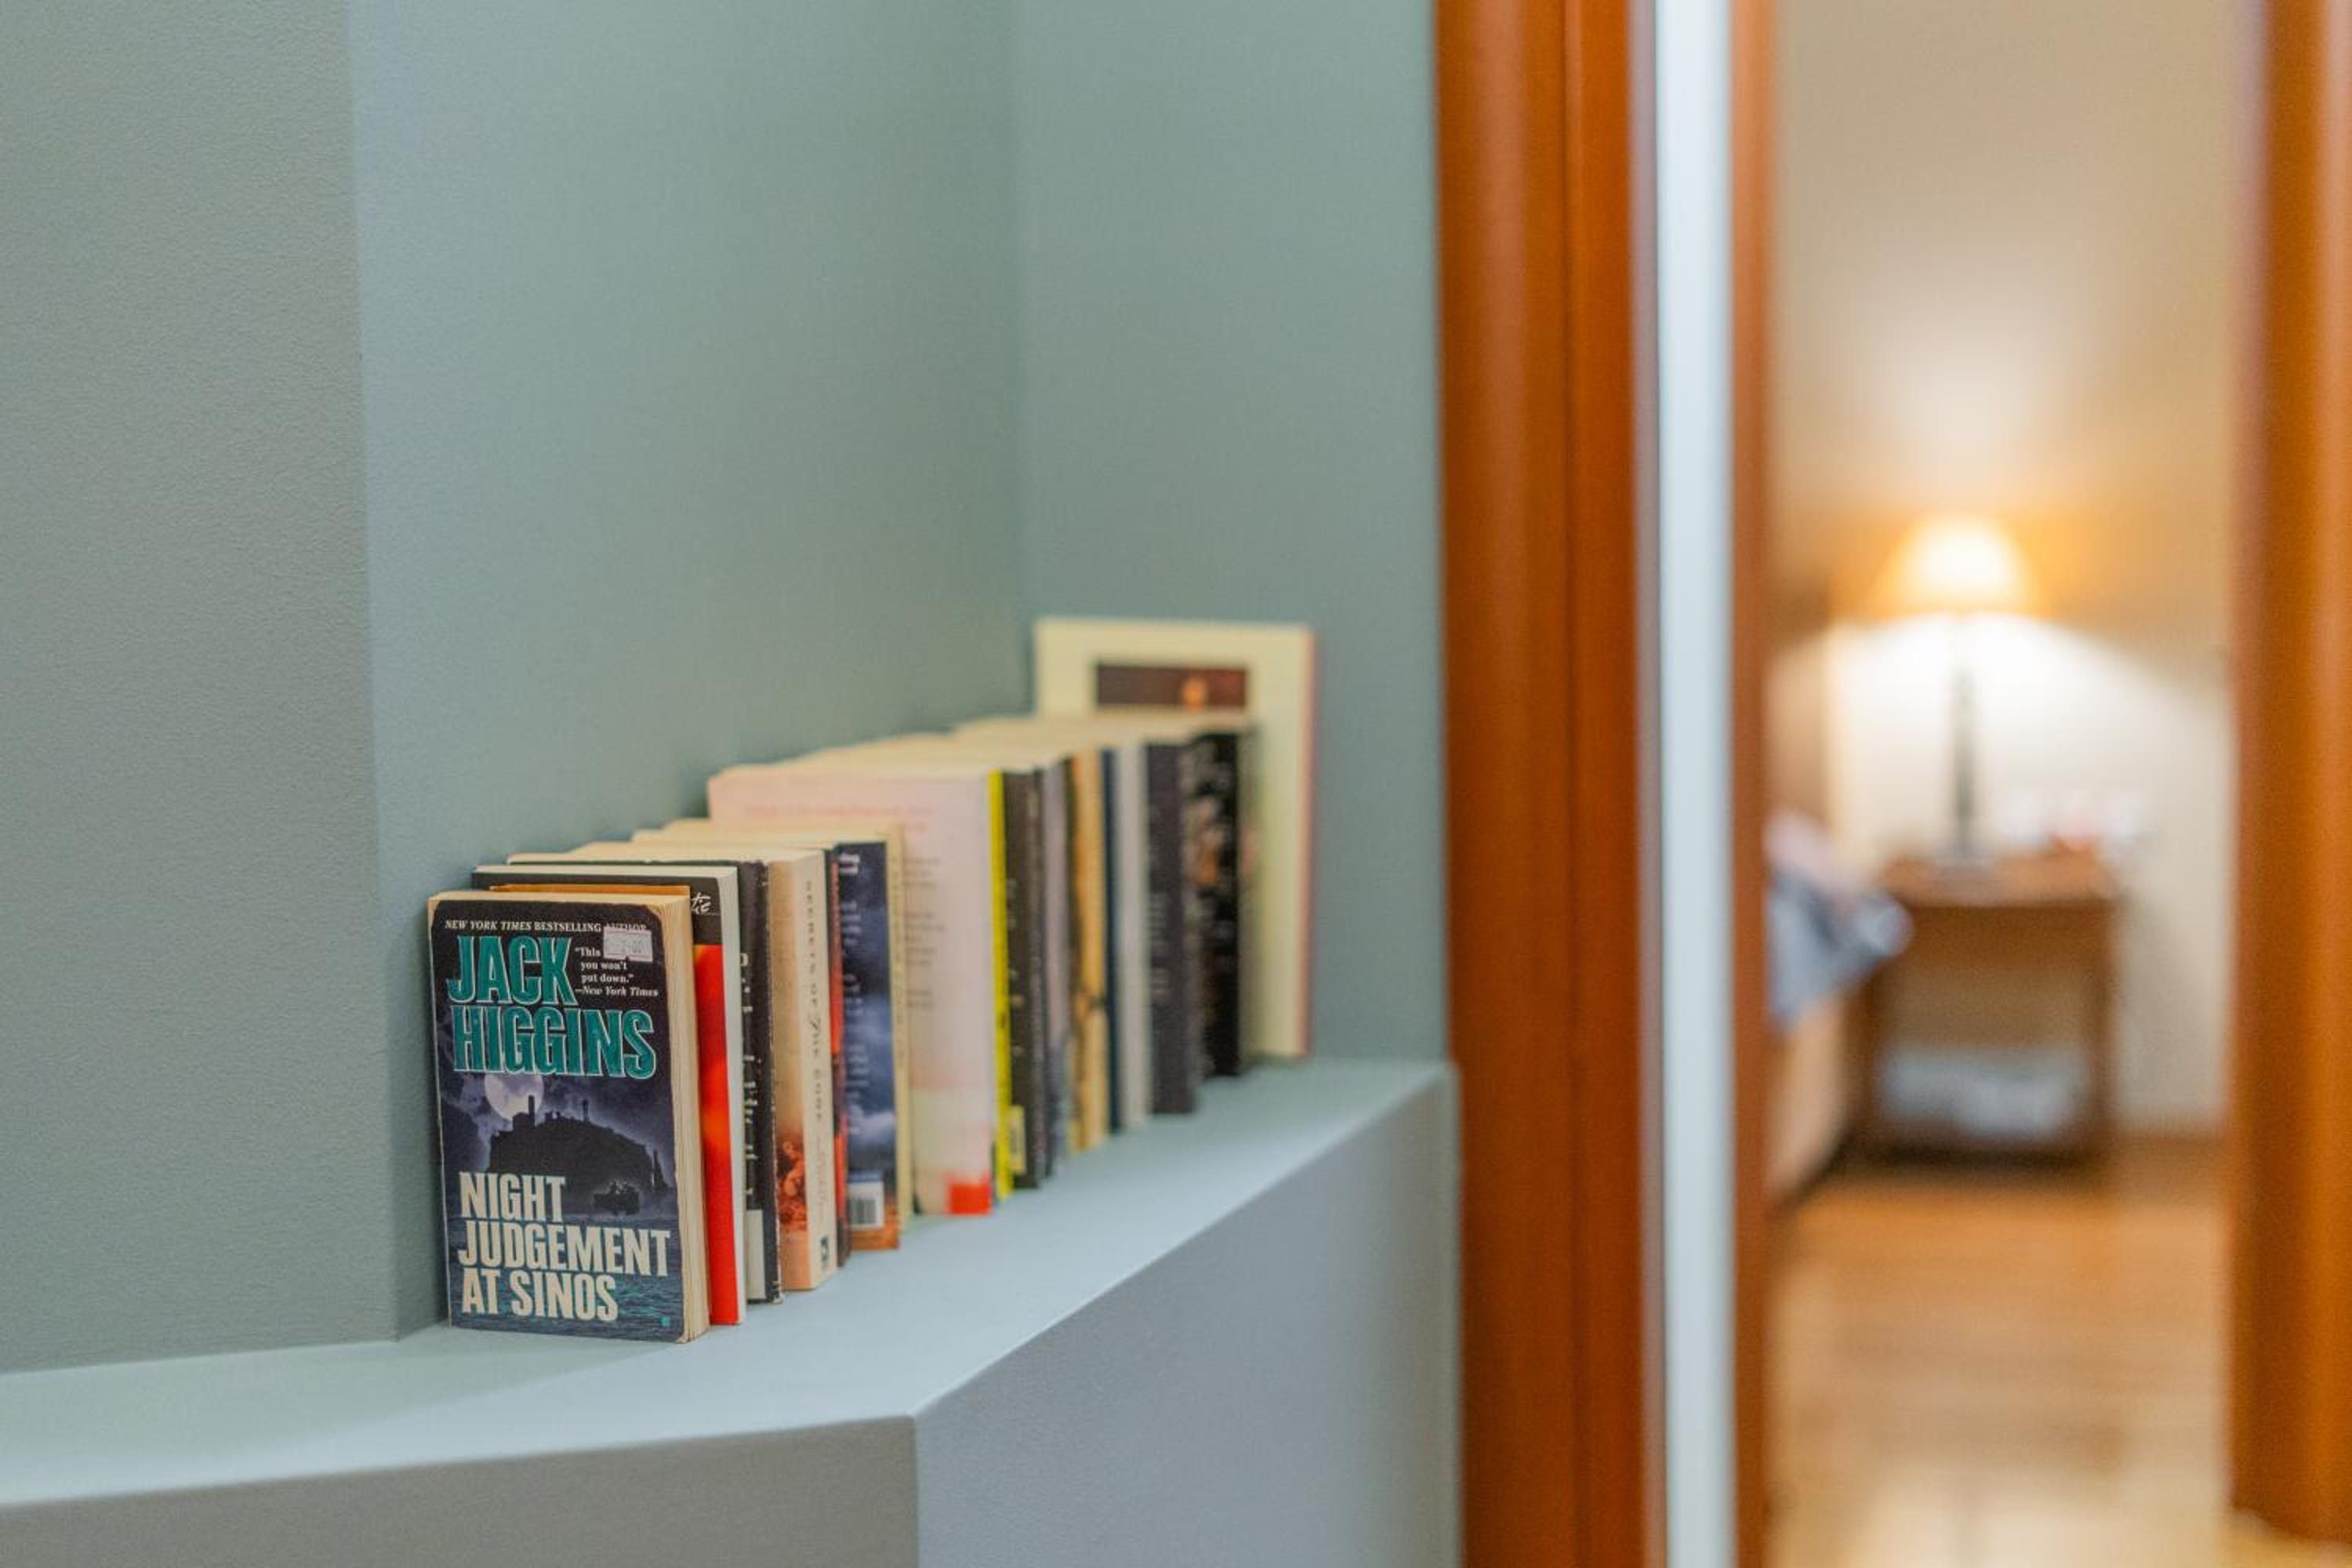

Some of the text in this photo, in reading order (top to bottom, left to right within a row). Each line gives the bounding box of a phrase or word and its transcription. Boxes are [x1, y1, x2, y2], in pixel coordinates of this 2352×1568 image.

[445, 920, 468, 929] NEW
[470, 920, 498, 930] YORK
[500, 921, 532, 931] TIMES
[534, 921, 602, 932] BESTSELLING
[446, 935, 578, 1005] JACK
[580, 960, 628, 971] you won't
[581, 974, 597, 984] put
[605, 986, 626, 996] York
[630, 987, 659, 996] Times
[452, 1005, 656, 1080] HIGGINS
[459, 1171, 566, 1222] NIGHT
[457, 1220, 671, 1276] JUDGEMENT
[462, 1268, 619, 1323] AT SINOS
